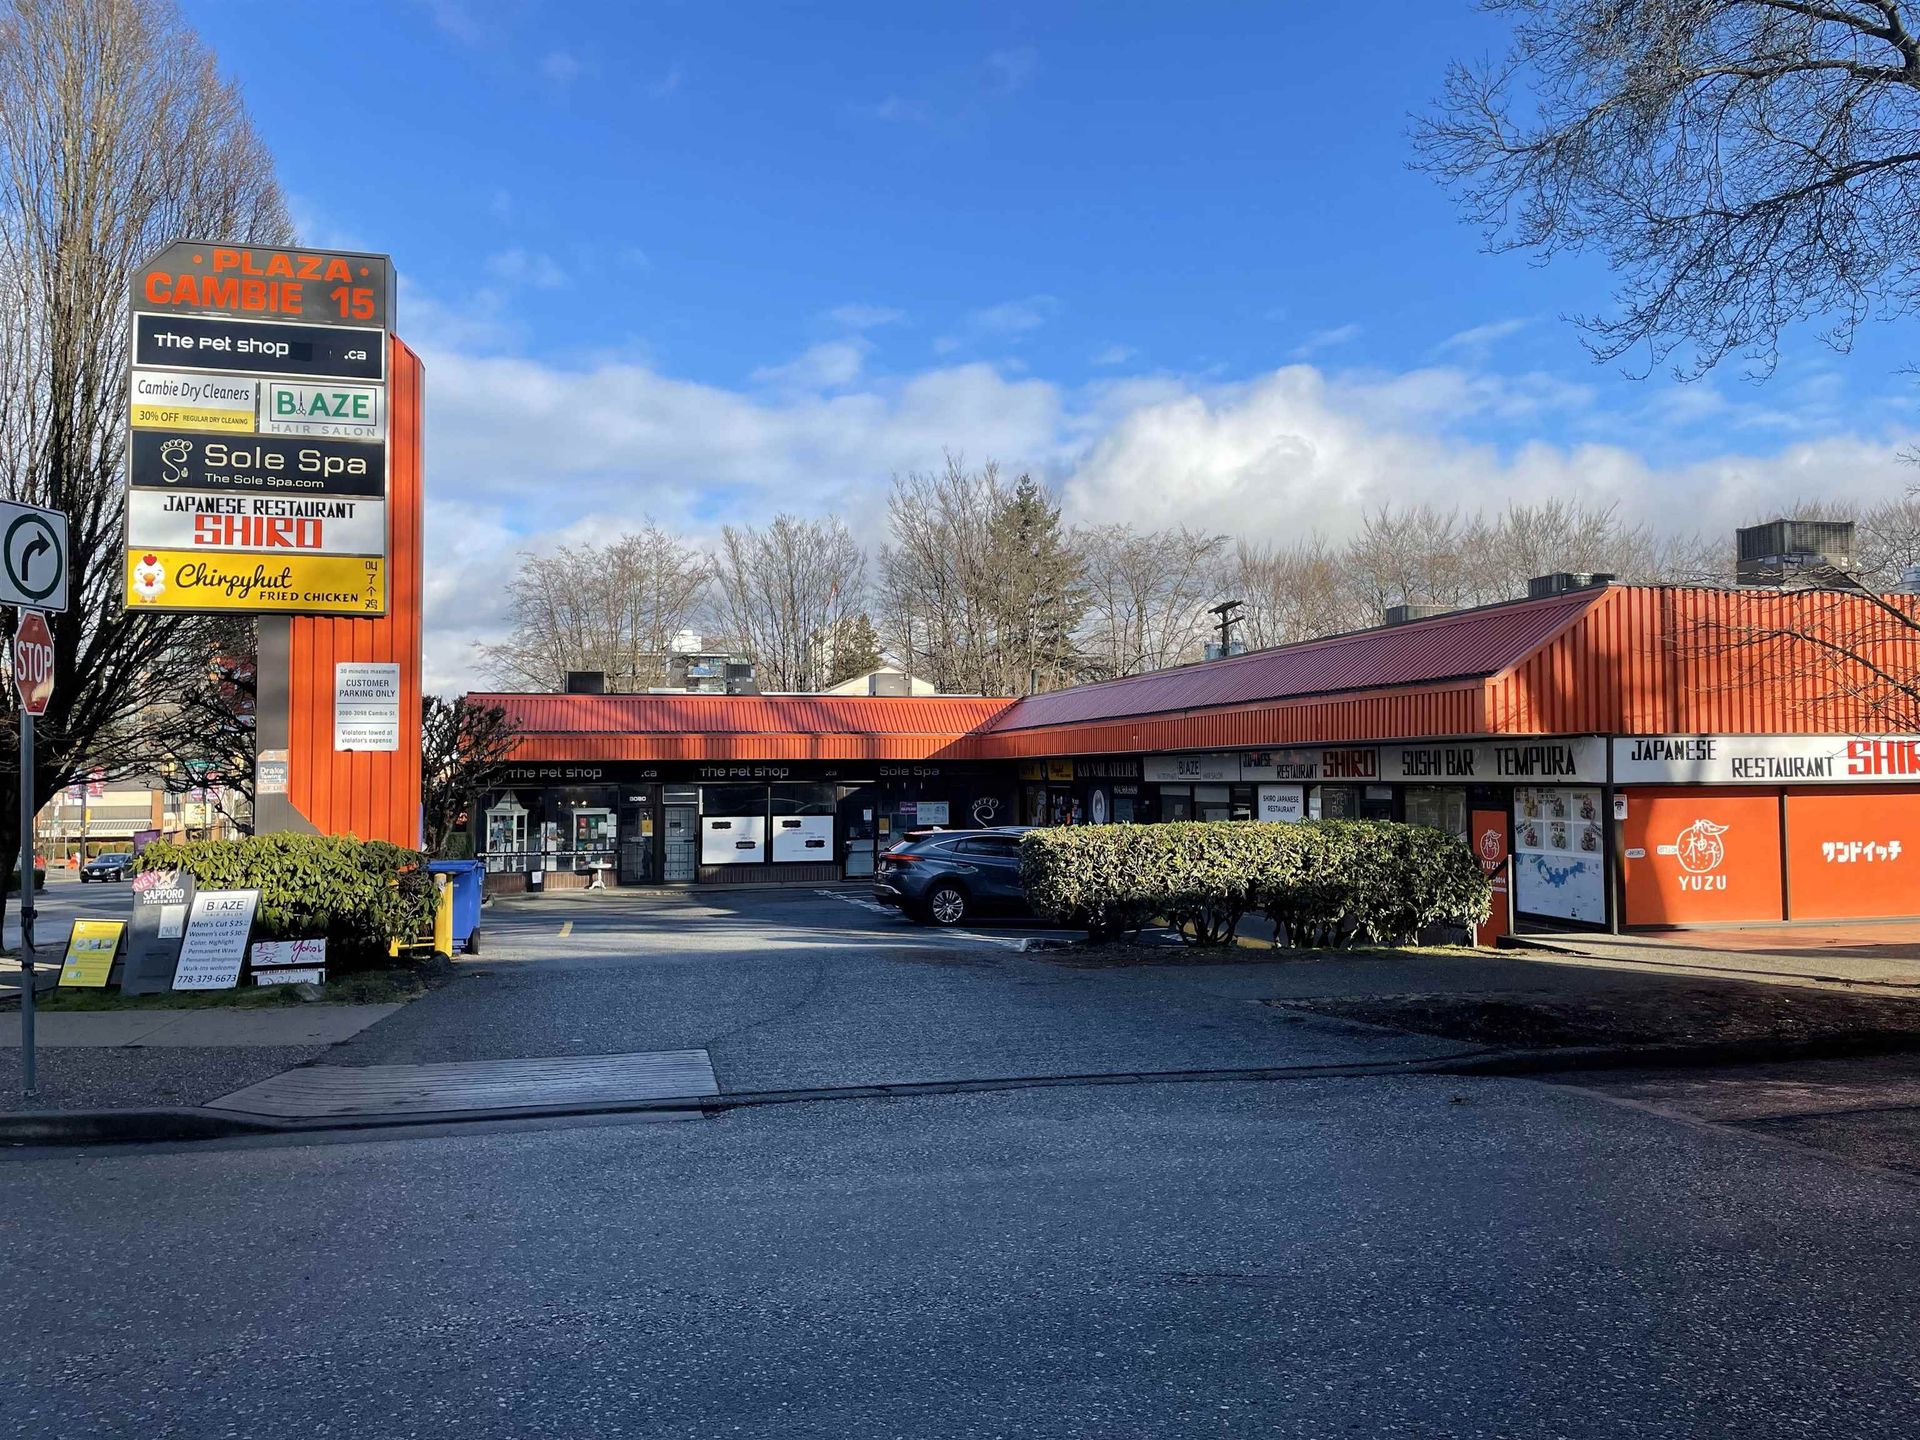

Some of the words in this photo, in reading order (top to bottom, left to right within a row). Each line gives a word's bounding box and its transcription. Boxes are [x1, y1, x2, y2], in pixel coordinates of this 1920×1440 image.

[213, 248, 353, 282] PLAZA
[145, 271, 303, 314] CAMBIE
[330, 287, 375, 319] 15
[344, 349, 367, 360] .ca
[138, 379, 178, 397] Cambie
[181, 382, 201, 401] Dry
[203, 383, 249, 401] Cleaners
[139, 410, 159, 422] 30%
[160, 412, 179, 423] OFF
[182, 415, 208, 423] REGULAR
[209, 416, 220, 424] DRY
[221, 416, 248, 425] CLEANING
[271, 424, 311, 434] HAIR
[322, 425, 375, 437] SALON
[205, 443, 284, 470] Sole
[299, 449, 367, 477] Spa
[205, 473, 230, 483] The
[234, 474, 263, 485] Sole
[267, 476, 324, 488] Spa.com
[164, 495, 246, 515] JAPANESE
[253, 499, 355, 519] RESTAURANT
[194, 515, 322, 548] SHIRO
[175, 563, 293, 598] Chirpyhut
[259, 591, 299, 601] FRIED
[304, 592, 359, 602] CHICKEN
[17, 640, 52, 683] STOP
[346, 679, 389, 687] CUSTOMER
[375, 690, 395, 698] ONLY
[1243, 751, 1272, 767] JAPANESE
[1277, 764, 1318, 779] RESTAURANT
[1323, 750, 1376, 777] SHIRO
[1402, 750, 1441, 776] SUSHI
[1447, 749, 1474, 776] BAR
[1494, 745, 1577, 776] TEMPURA
[1632, 740, 1716, 760] JAPANESE
[1732, 757, 1833, 778] RESTAURANT
[879, 765, 910, 776] Sole
[913, 767, 941, 778] Spa
[1263, 794, 1276, 802] SHIRO
[1277, 795, 1299, 803] JAPANESE
[1267, 805, 1295, 813] RESTAURANT
[1822, 841, 1902, 863] サンドイッチ
[133, 871, 158, 891] NEW
[1678, 875, 1726, 890] YUZU
[143, 888, 184, 900] SAPPORO
[191, 920, 214, 928] Men's
[215, 920, 228, 928] Cut
[188, 930, 218, 938] Women's
[177, 974, 238, 984] 778-379-6673
